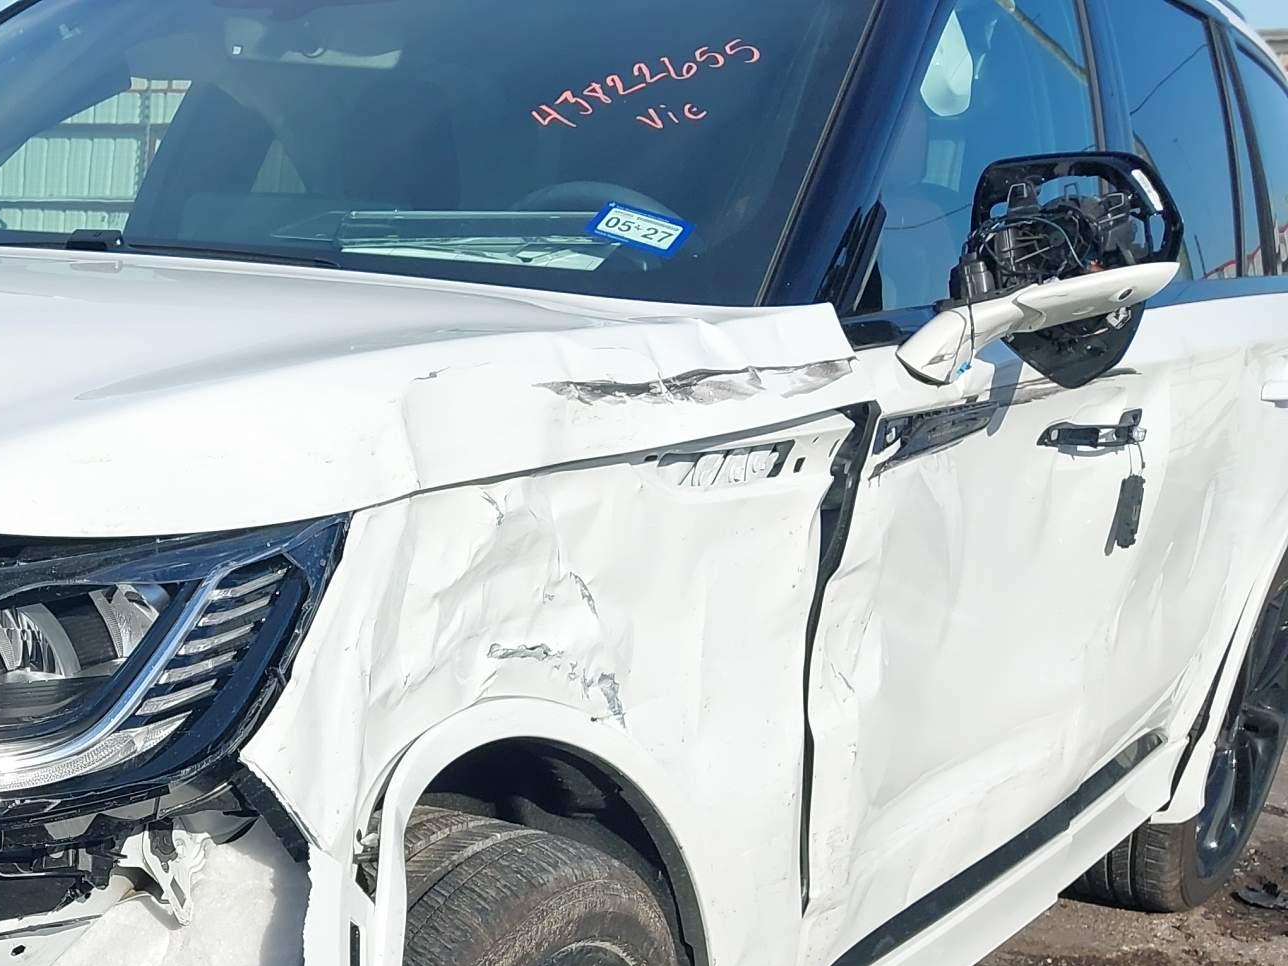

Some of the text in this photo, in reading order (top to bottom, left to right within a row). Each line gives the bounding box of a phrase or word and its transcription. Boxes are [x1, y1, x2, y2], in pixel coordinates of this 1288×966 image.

[531, 39, 760, 128] 43822655
[605, 216, 635, 233] 05
[641, 226, 673, 243] 27
